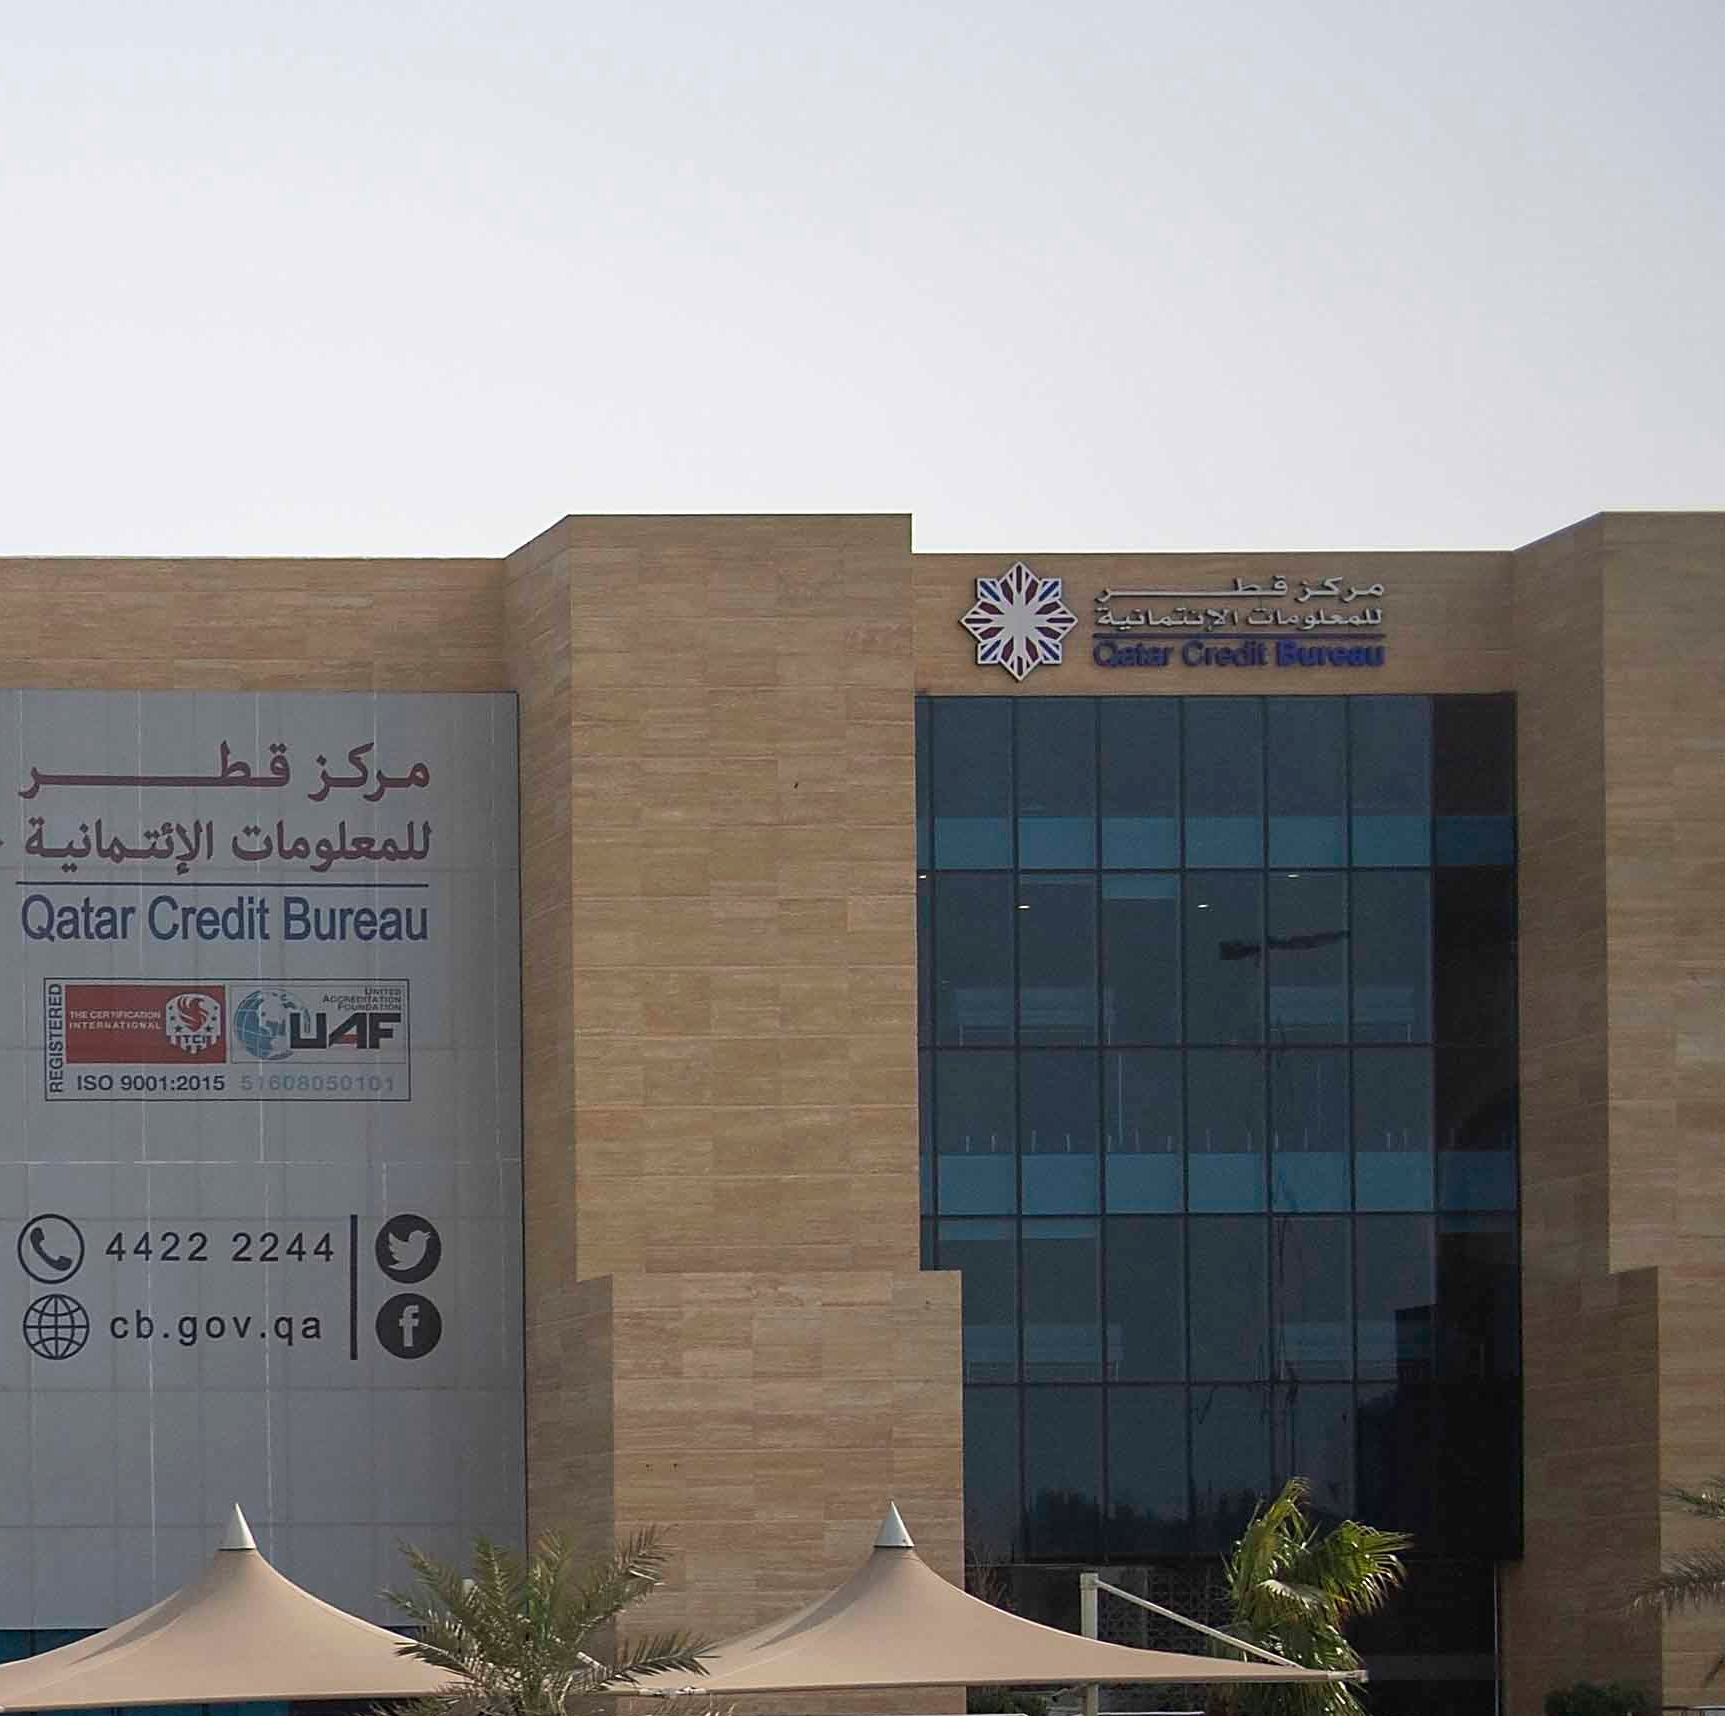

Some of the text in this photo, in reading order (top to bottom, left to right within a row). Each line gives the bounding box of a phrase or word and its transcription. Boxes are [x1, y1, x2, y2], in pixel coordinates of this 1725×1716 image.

[1297, 577, 1384, 602] مركز
[1247, 607, 1382, 631] للمعلومات
[1093, 640, 1386, 667] Qatar Credit Bureau
[18, 740, 430, 801] مركز قطر
[231, 820, 432, 872] للمعلومات
[21, 895, 429, 941] Qatar Credit Bureau
[69, 1010, 161, 1019] THE CERTIFICATION
[69, 1021, 161, 1030] INTERNATIONAL
[49, 983, 63, 1093] REGISTERED
[289, 1013, 401, 1049] UAF
[77, 1075, 225, 1092] ISO 9001:2015
[105, 1232, 335, 1262] 4422 2244
[109, 1309, 323, 1346] cb.gov.qa
